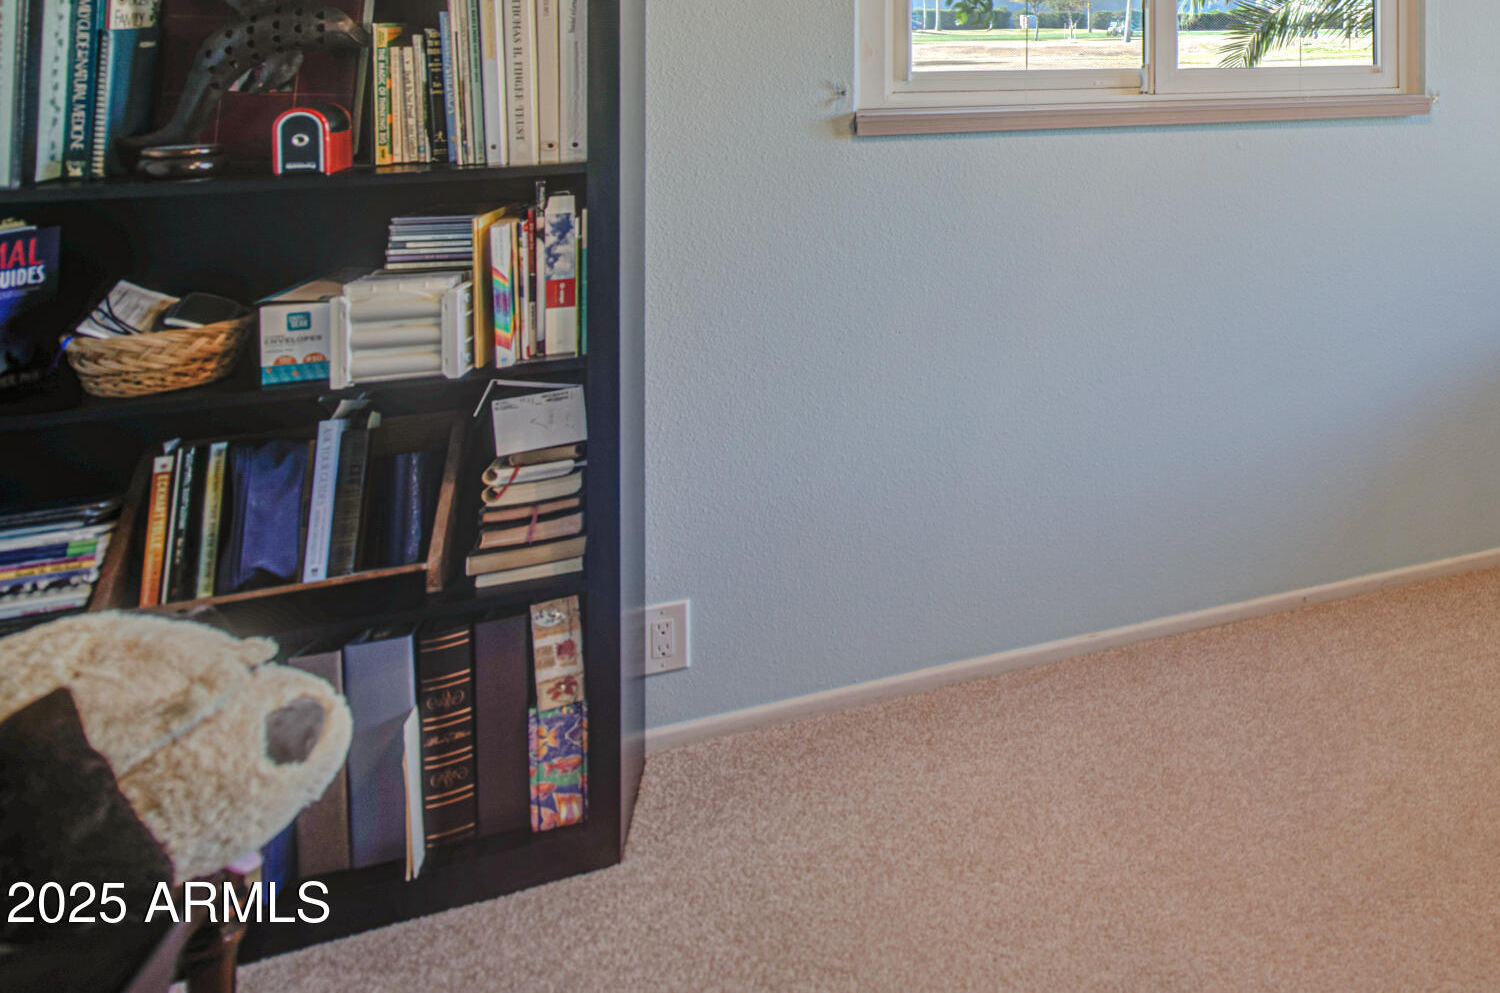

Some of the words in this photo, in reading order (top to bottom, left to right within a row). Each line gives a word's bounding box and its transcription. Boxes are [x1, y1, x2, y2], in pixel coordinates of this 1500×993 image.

[75, 20, 91, 49] GUIDE
[72, 58, 89, 102] NATURAL
[378, 62, 386, 84] MAGIC
[69, 104, 86, 150] MEDICINE
[378, 97, 387, 130] THINKING
[514, 105, 525, 142] TRUST
[264, 334, 323, 345] ENVELOPES
